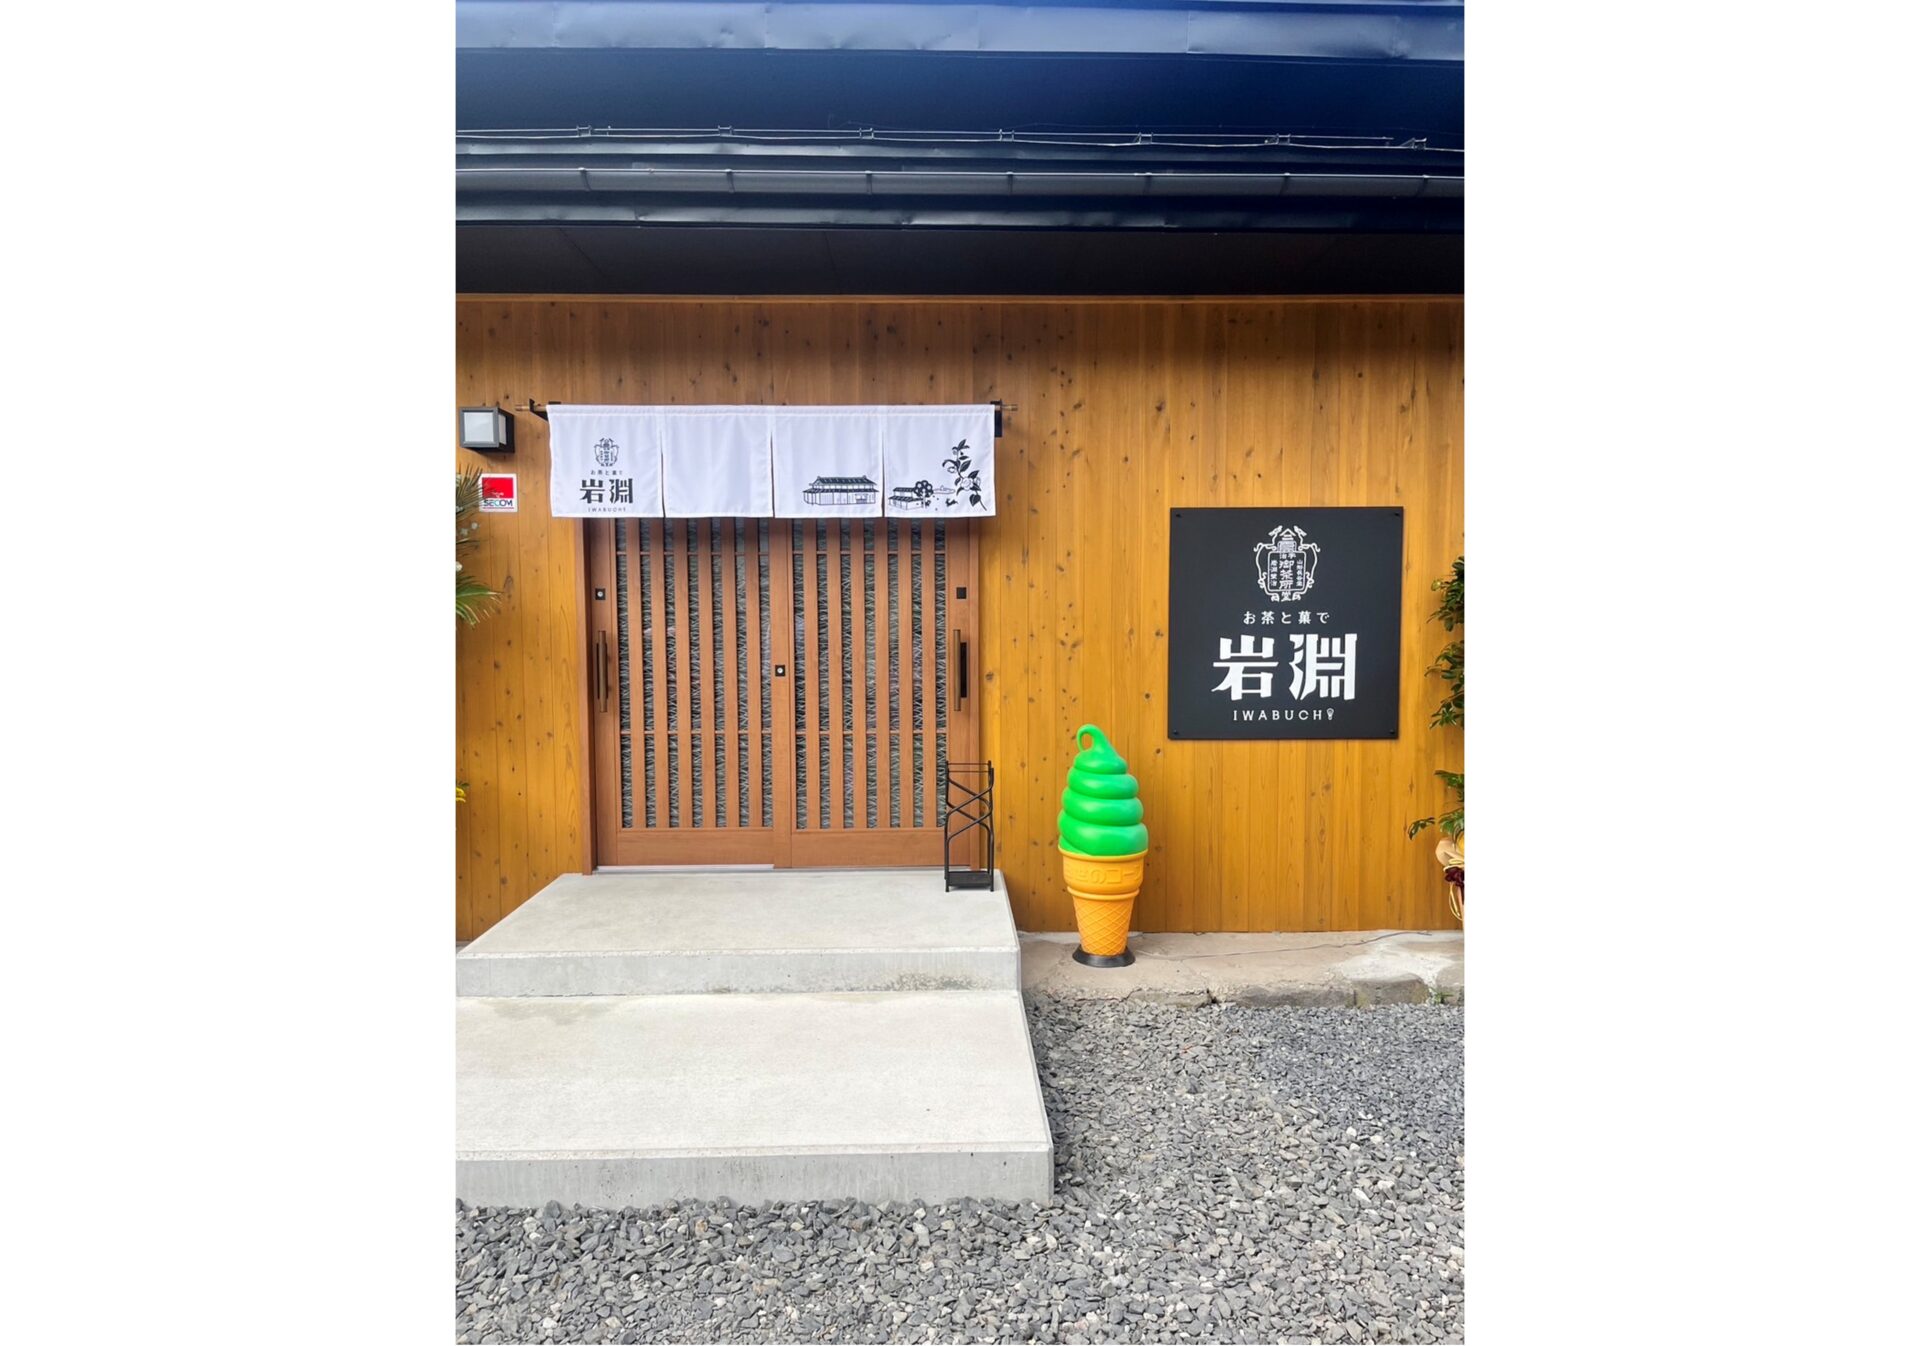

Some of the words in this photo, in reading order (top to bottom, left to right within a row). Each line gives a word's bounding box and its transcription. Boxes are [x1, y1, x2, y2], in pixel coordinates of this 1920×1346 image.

[579, 478, 633, 503] 岩淵
[1243, 611, 1330, 624] お茶と菓で
[1211, 633, 1357, 700] 岩淵
